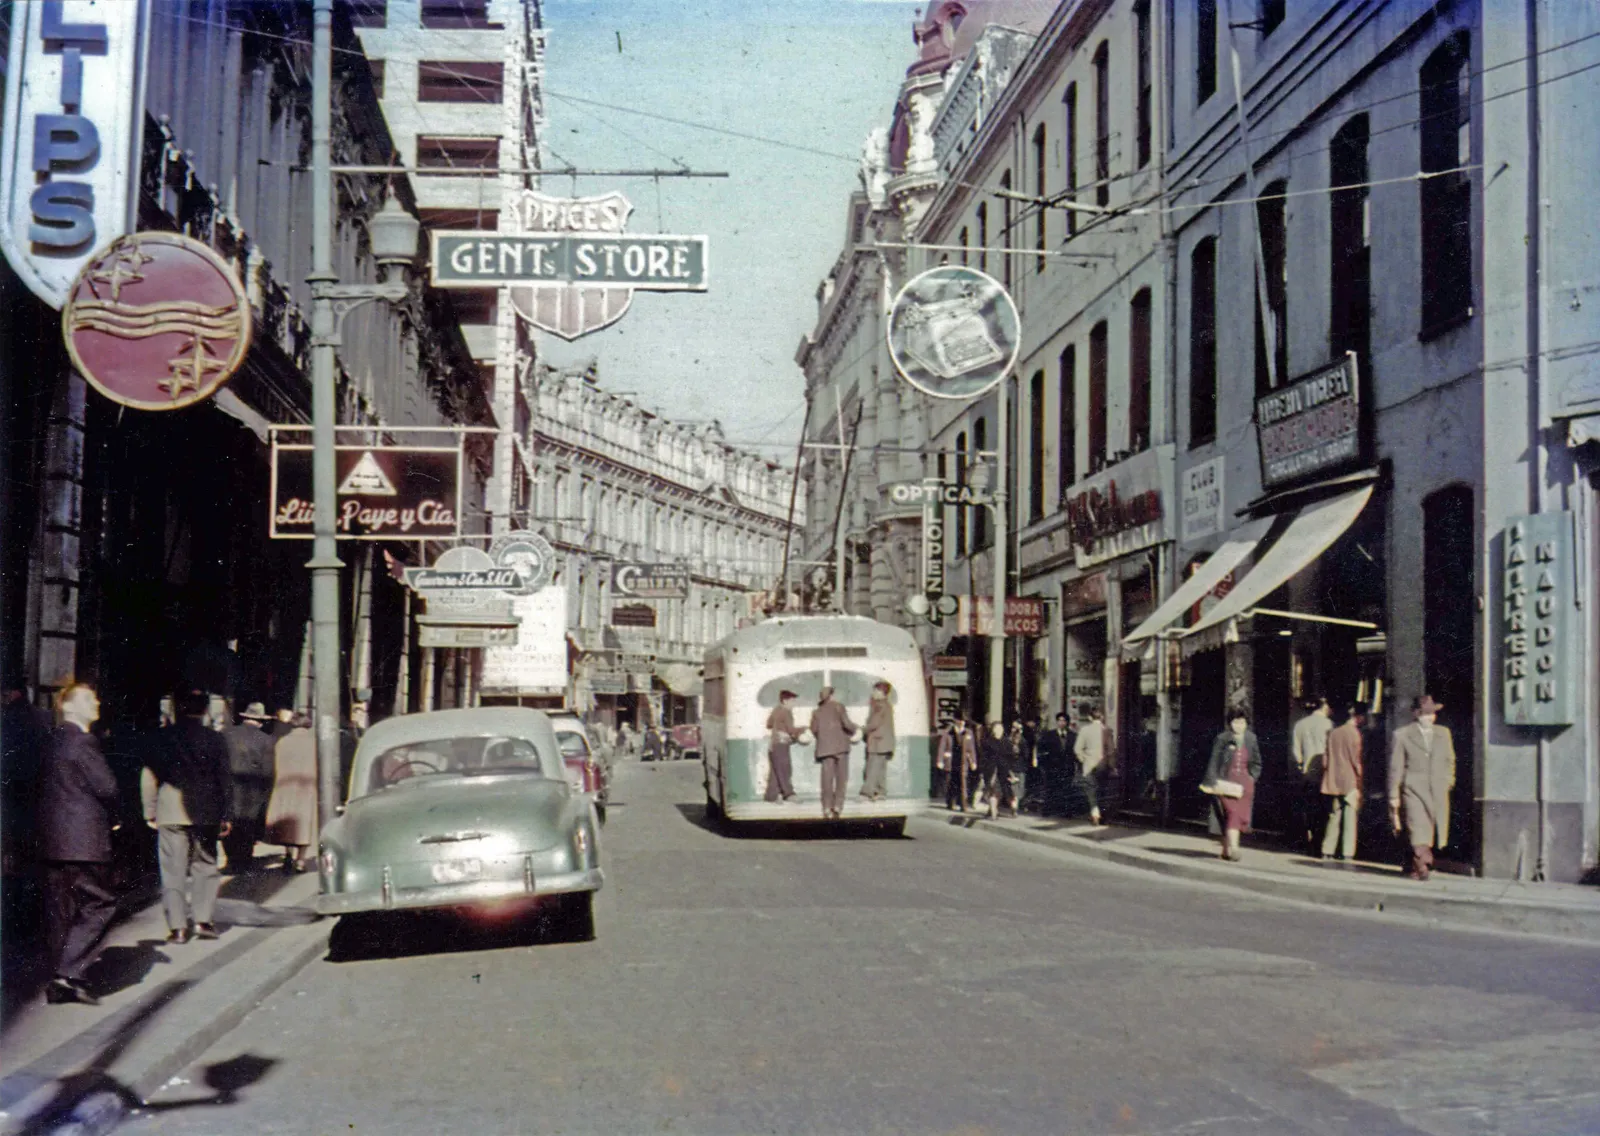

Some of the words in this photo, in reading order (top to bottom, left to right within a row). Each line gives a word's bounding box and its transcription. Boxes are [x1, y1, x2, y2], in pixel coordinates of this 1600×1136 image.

[525, 198, 617, 231] PRICES
[575, 243, 690, 277] STORE
[892, 485, 973, 502] OPTICA
[341, 500, 398, 531] Paye
[400, 508, 414, 531] y
[926, 507, 943, 592] LOPEZ
[980, 617, 1039, 631] TAACOS
[1536, 540, 1557, 702] NAUDON
